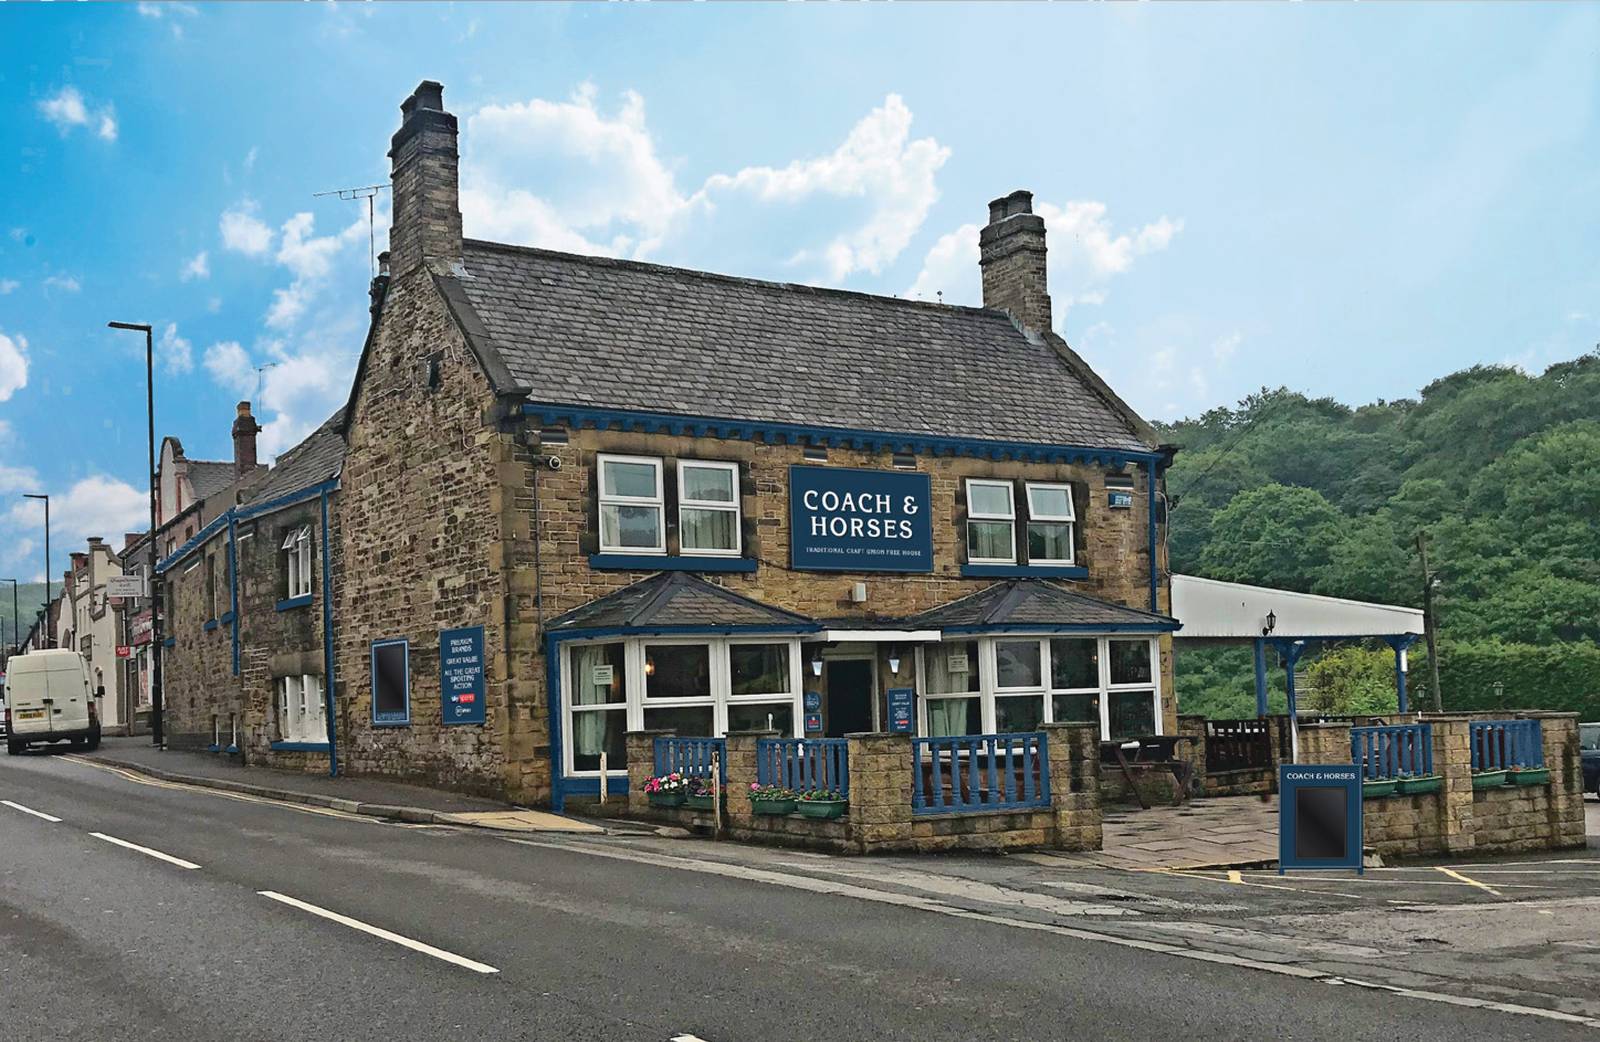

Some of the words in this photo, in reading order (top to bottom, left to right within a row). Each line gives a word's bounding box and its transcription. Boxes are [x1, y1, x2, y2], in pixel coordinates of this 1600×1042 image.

[803, 489, 891, 514] COACH
[903, 495, 919, 515] &
[810, 516, 913, 539] HORSES
[451, 645, 472, 653] BRANDS
[450, 675, 474, 683] SPORTING
[453, 682, 473, 690] ACTION
[1286, 772, 1314, 780] COACH
[1316, 772, 1322, 780] &
[1324, 772, 1355, 780] HORSES
